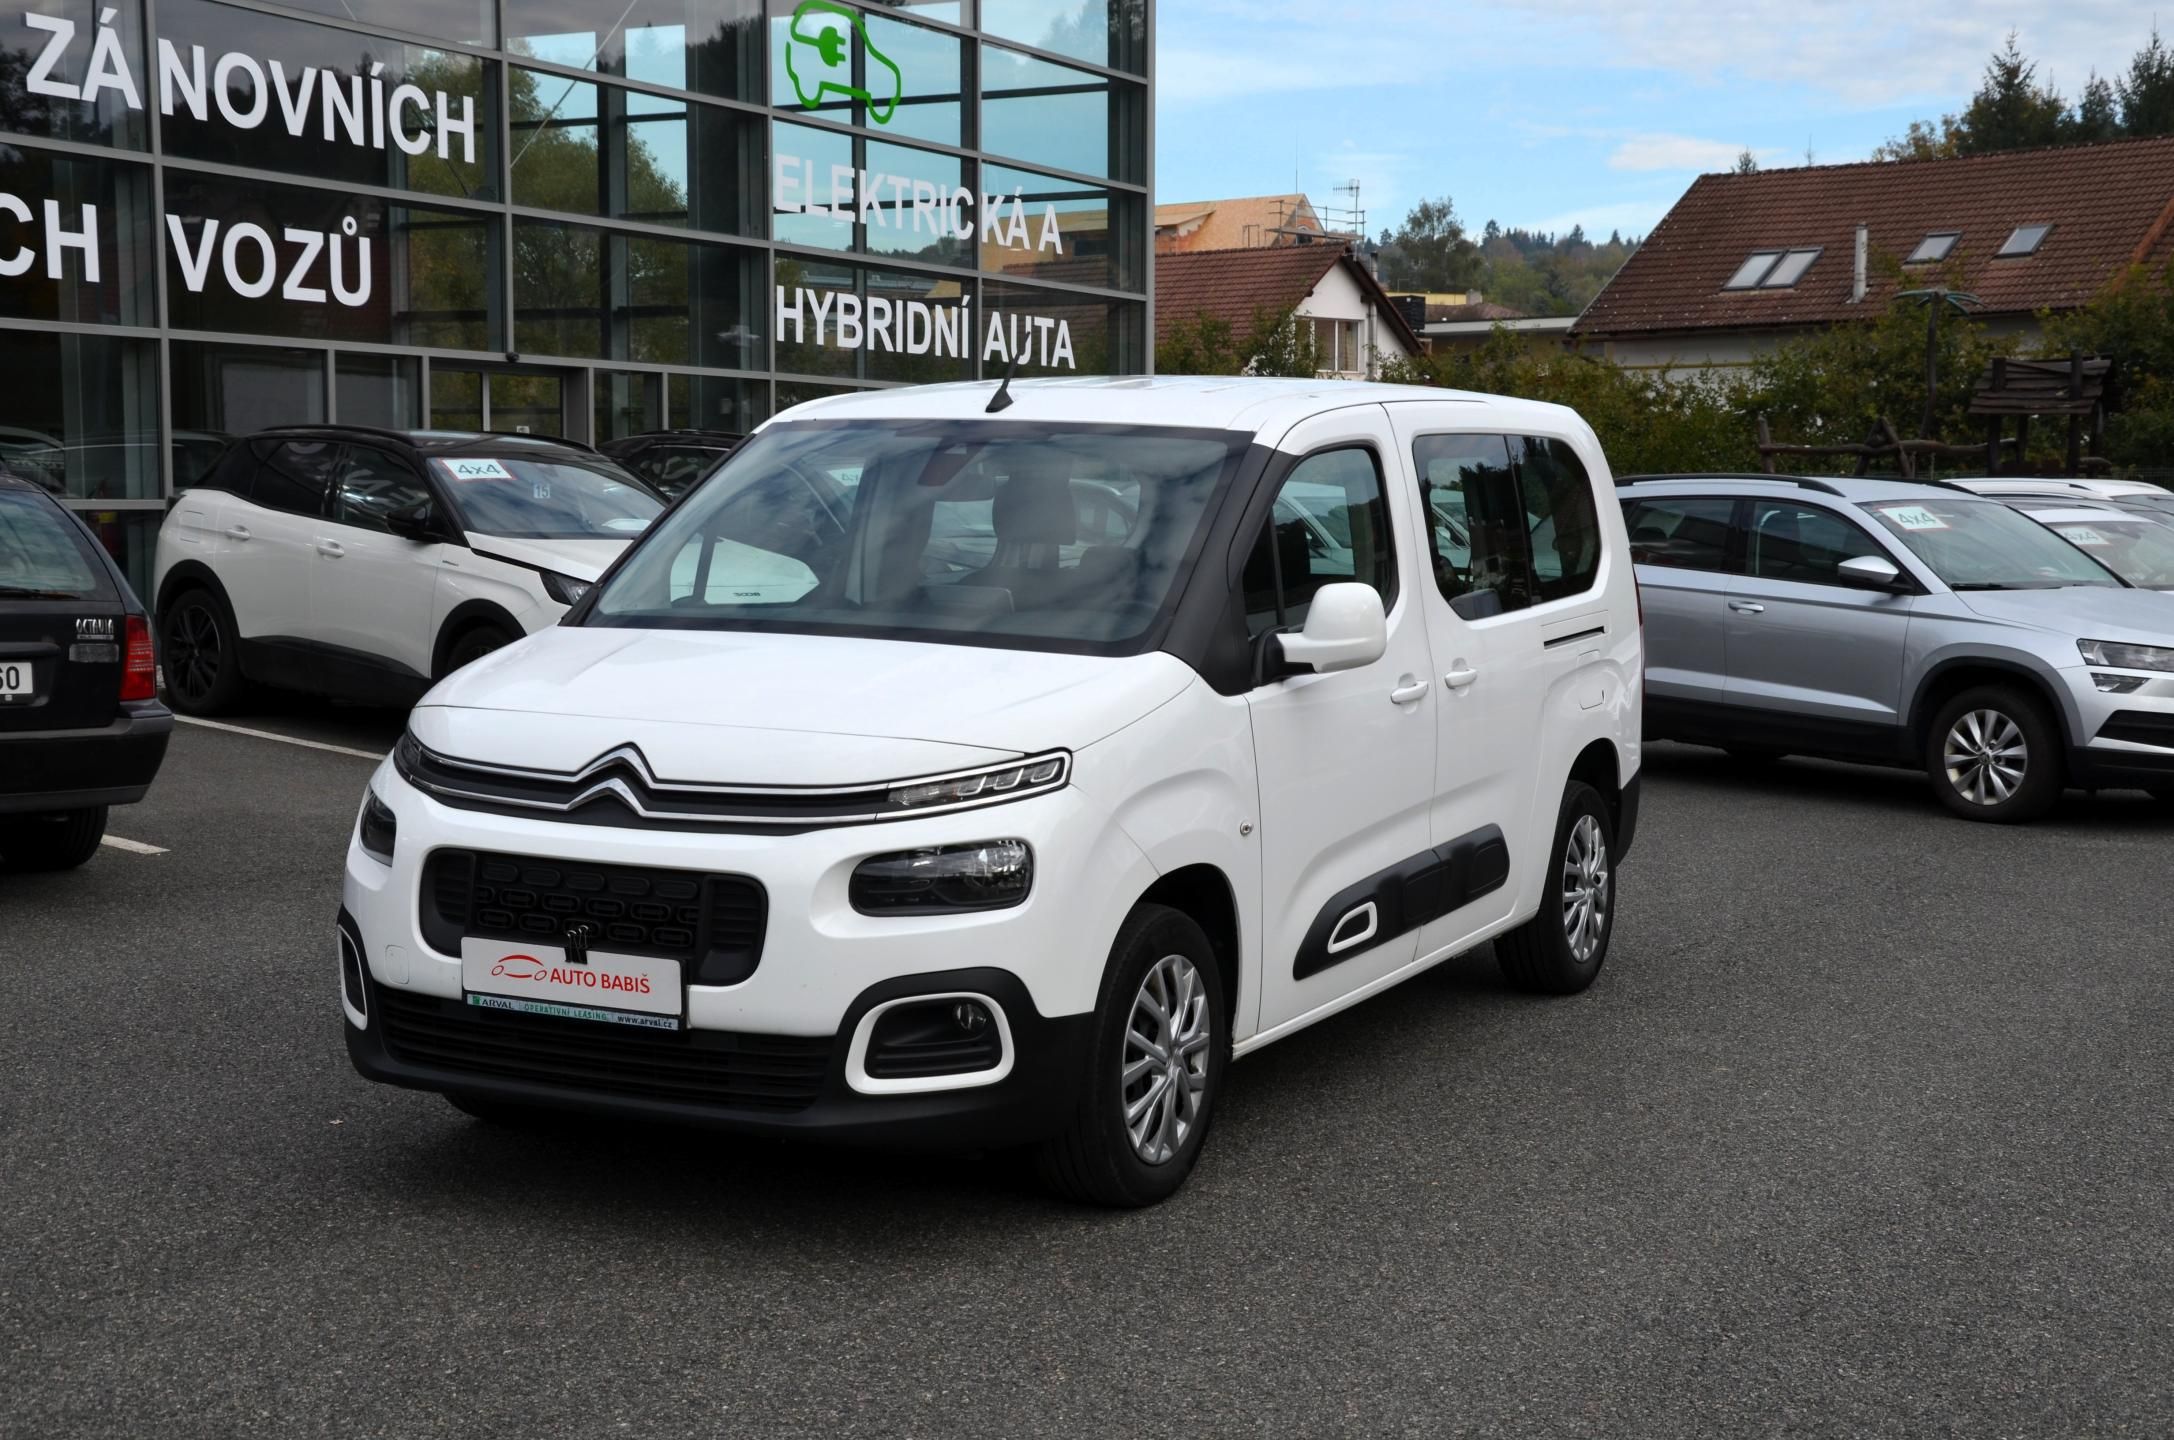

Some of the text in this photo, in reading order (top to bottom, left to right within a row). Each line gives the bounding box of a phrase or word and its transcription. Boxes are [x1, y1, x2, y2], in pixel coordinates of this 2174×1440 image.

[774, 153, 1063, 255] ELEKTRICKÁ A
[166, 214, 371, 307] VOZŮ
[776, 285, 1076, 370] HYBRIDNÍ AUTA
[76, 618, 114, 633] OCTAVIA
[550, 968, 650, 993] AUTO BABIŠ
[482, 999, 673, 1028] ARVAL OPERATIVNÍ LEASING www.arval.cz
